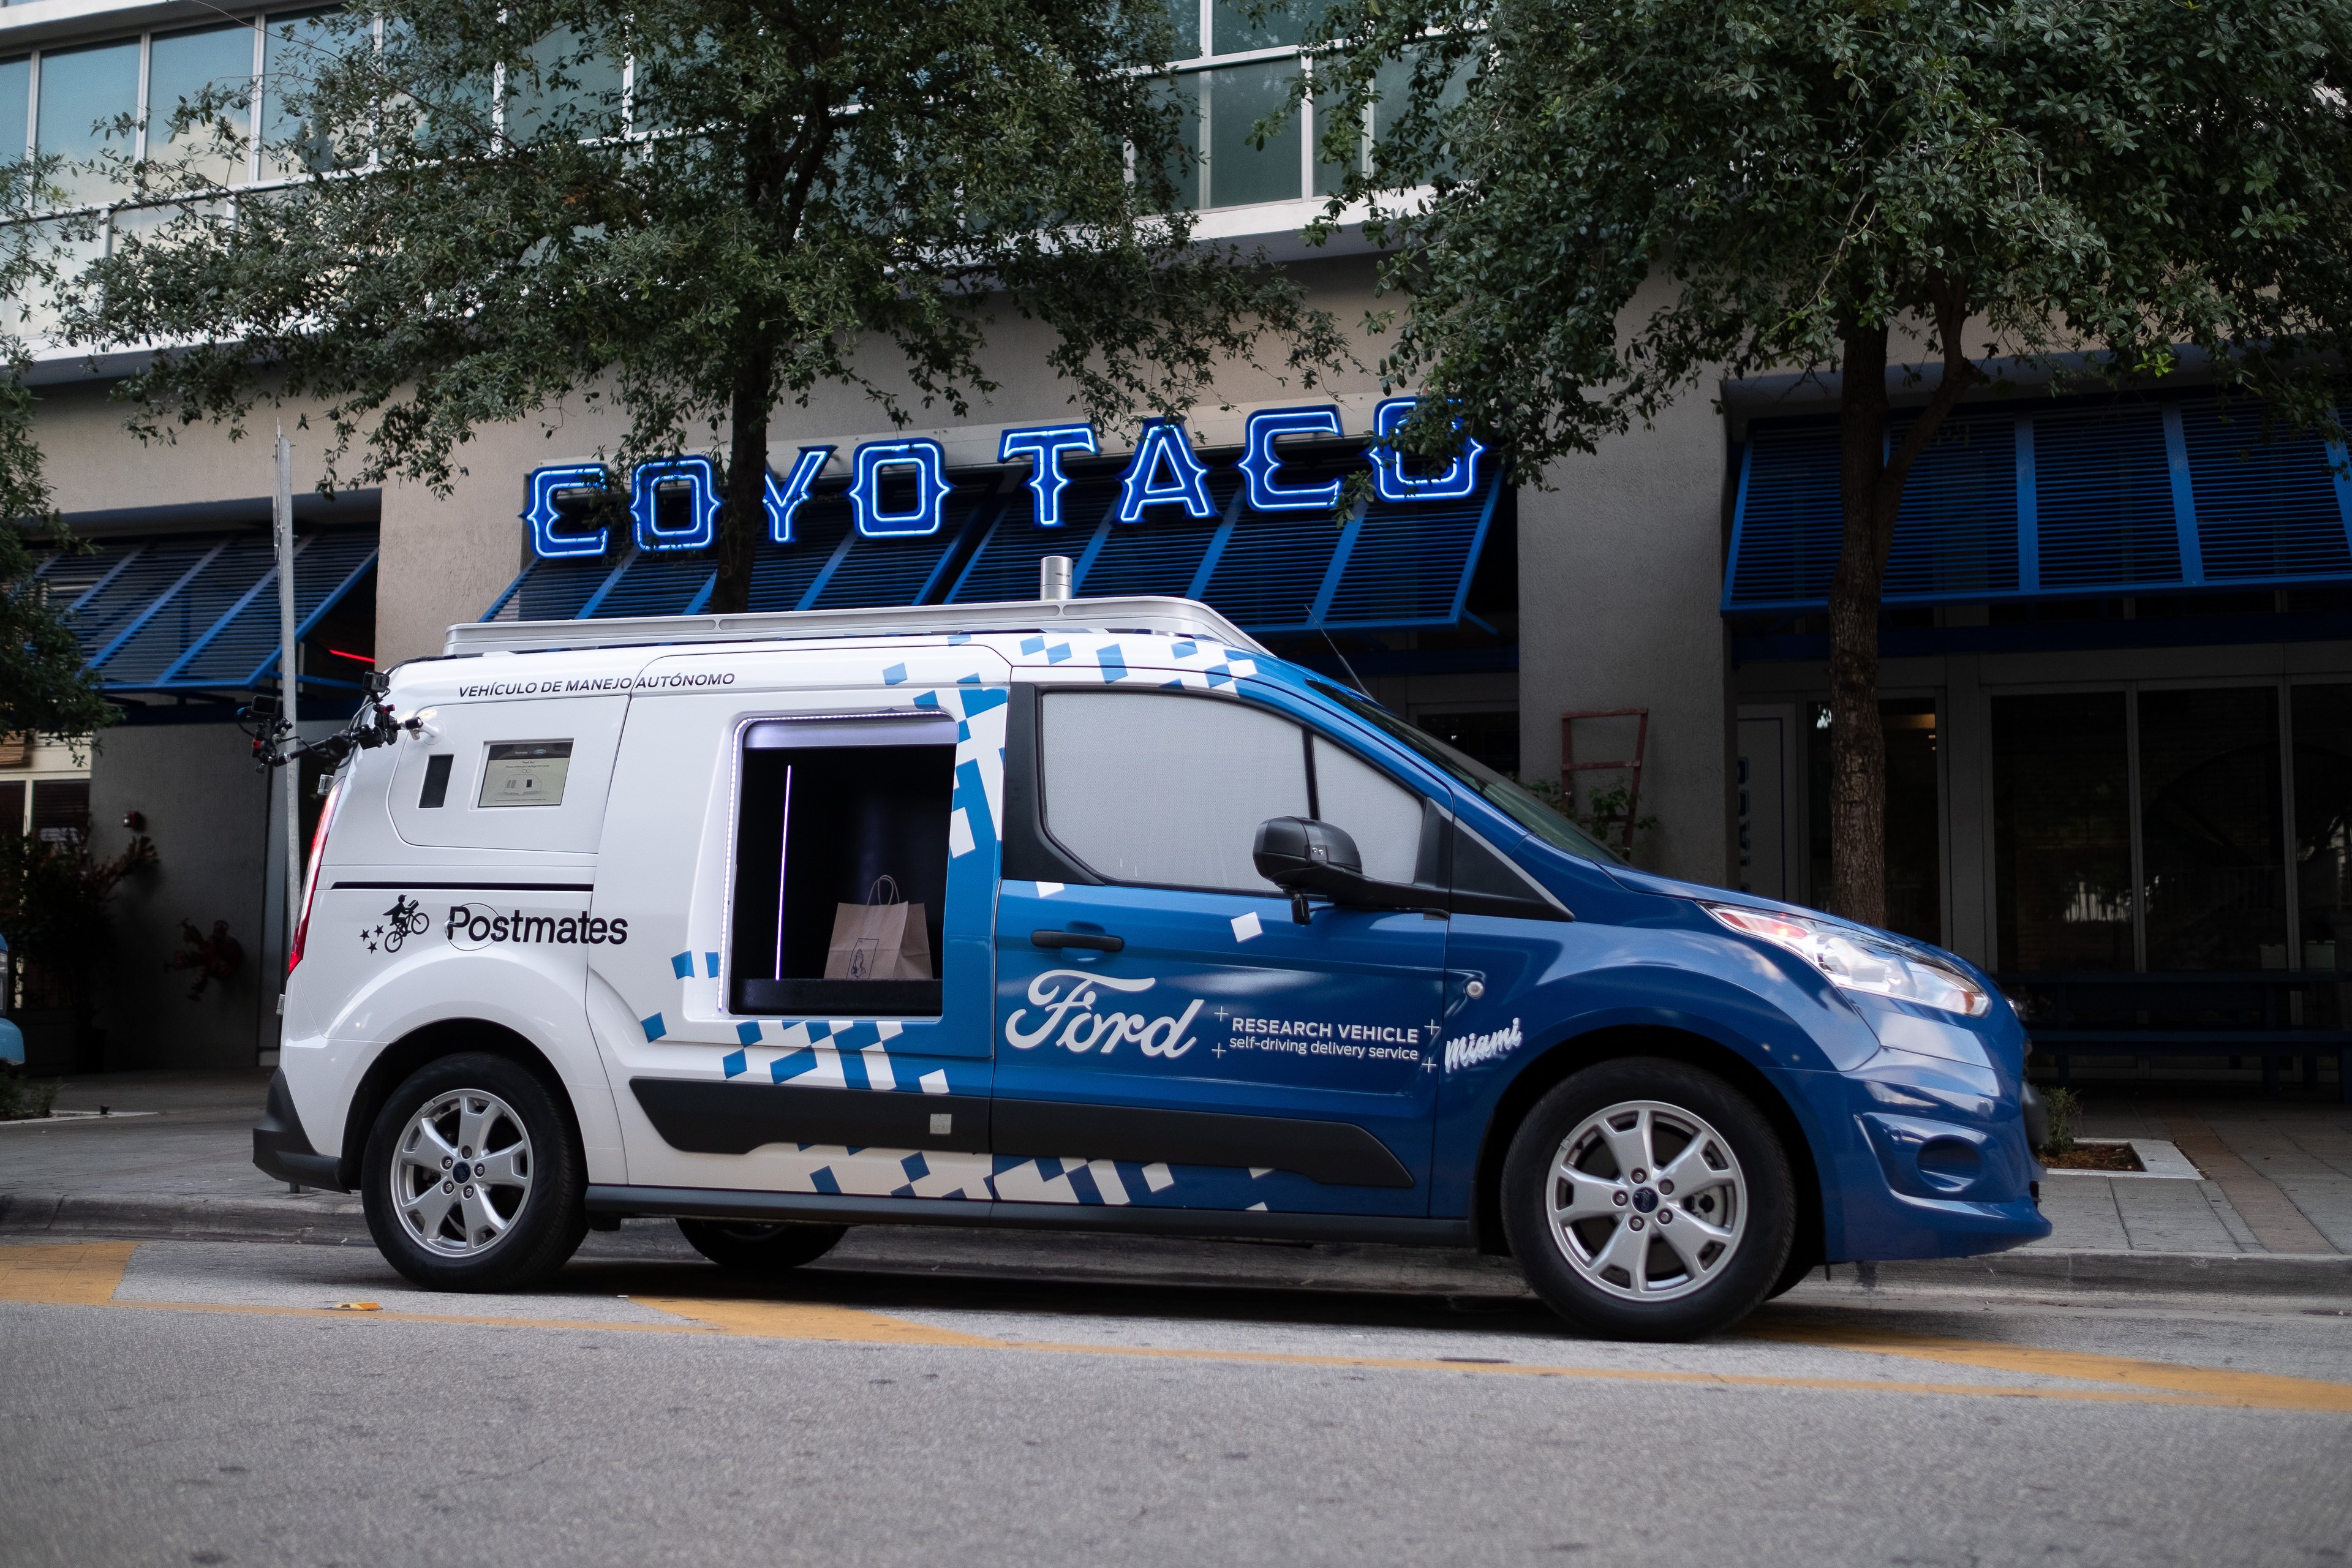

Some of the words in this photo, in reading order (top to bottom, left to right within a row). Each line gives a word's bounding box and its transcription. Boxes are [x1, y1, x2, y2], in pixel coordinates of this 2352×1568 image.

[518, 437, 954, 558] COYO
[997, 396, 1491, 527] TACO
[459, 681, 537, 698] VEHÍCULO
[541, 680, 562, 693] DE
[565, 677, 632, 692] MANEJO
[635, 673, 736, 688] AUTÓNOMO
[448, 906, 628, 945] Postmates
[1005, 969, 1205, 1058] Ford
[1232, 1017, 1332, 1038] RESEARCH
[1338, 1023, 1419, 1043] VEHICLE
[1229, 1036, 1307, 1055] self-driving
[1310, 1041, 1365, 1058] delivery
[1368, 1047, 1419, 1060] service
